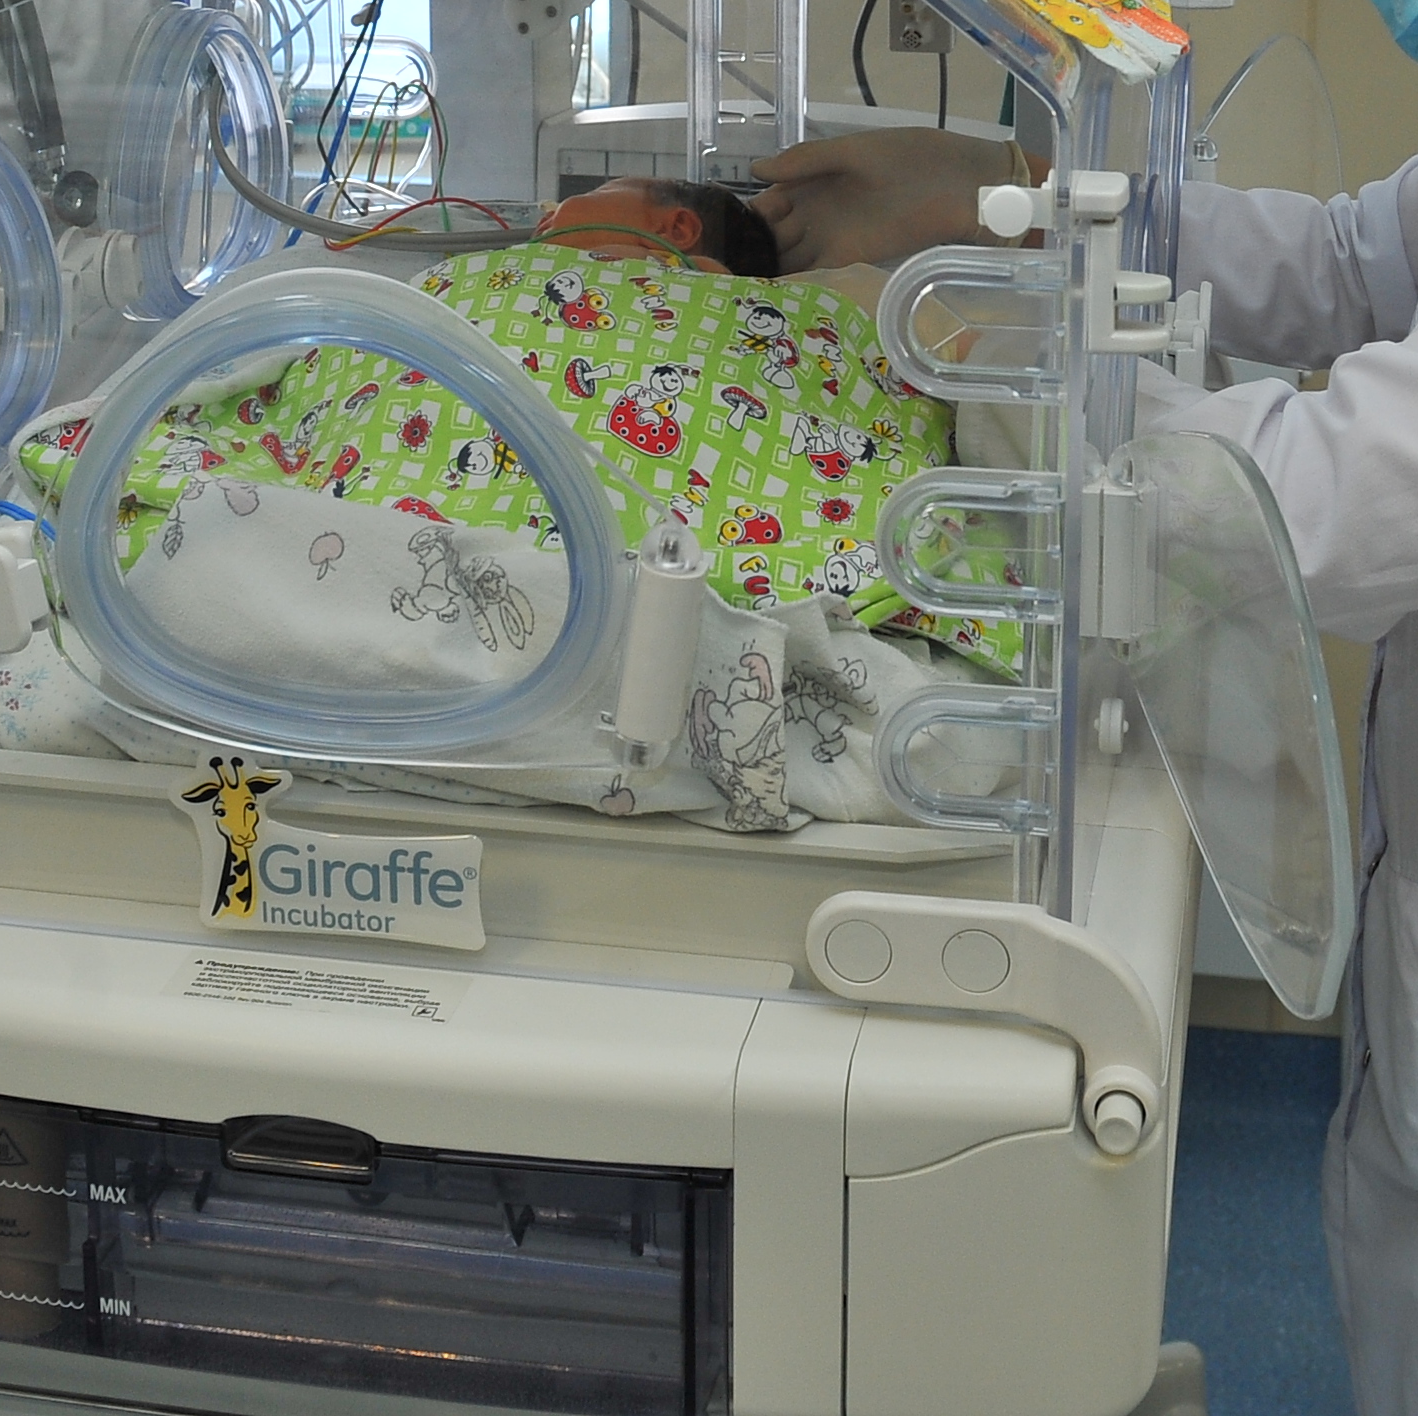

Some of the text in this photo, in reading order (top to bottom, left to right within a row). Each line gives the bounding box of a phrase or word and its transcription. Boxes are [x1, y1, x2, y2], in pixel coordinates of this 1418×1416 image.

[258, 843, 465, 909] Giraffe
[262, 901, 396, 933] Incubator
[89, 1184, 127, 1205] MAX
[100, 1297, 131, 1317] MIN
